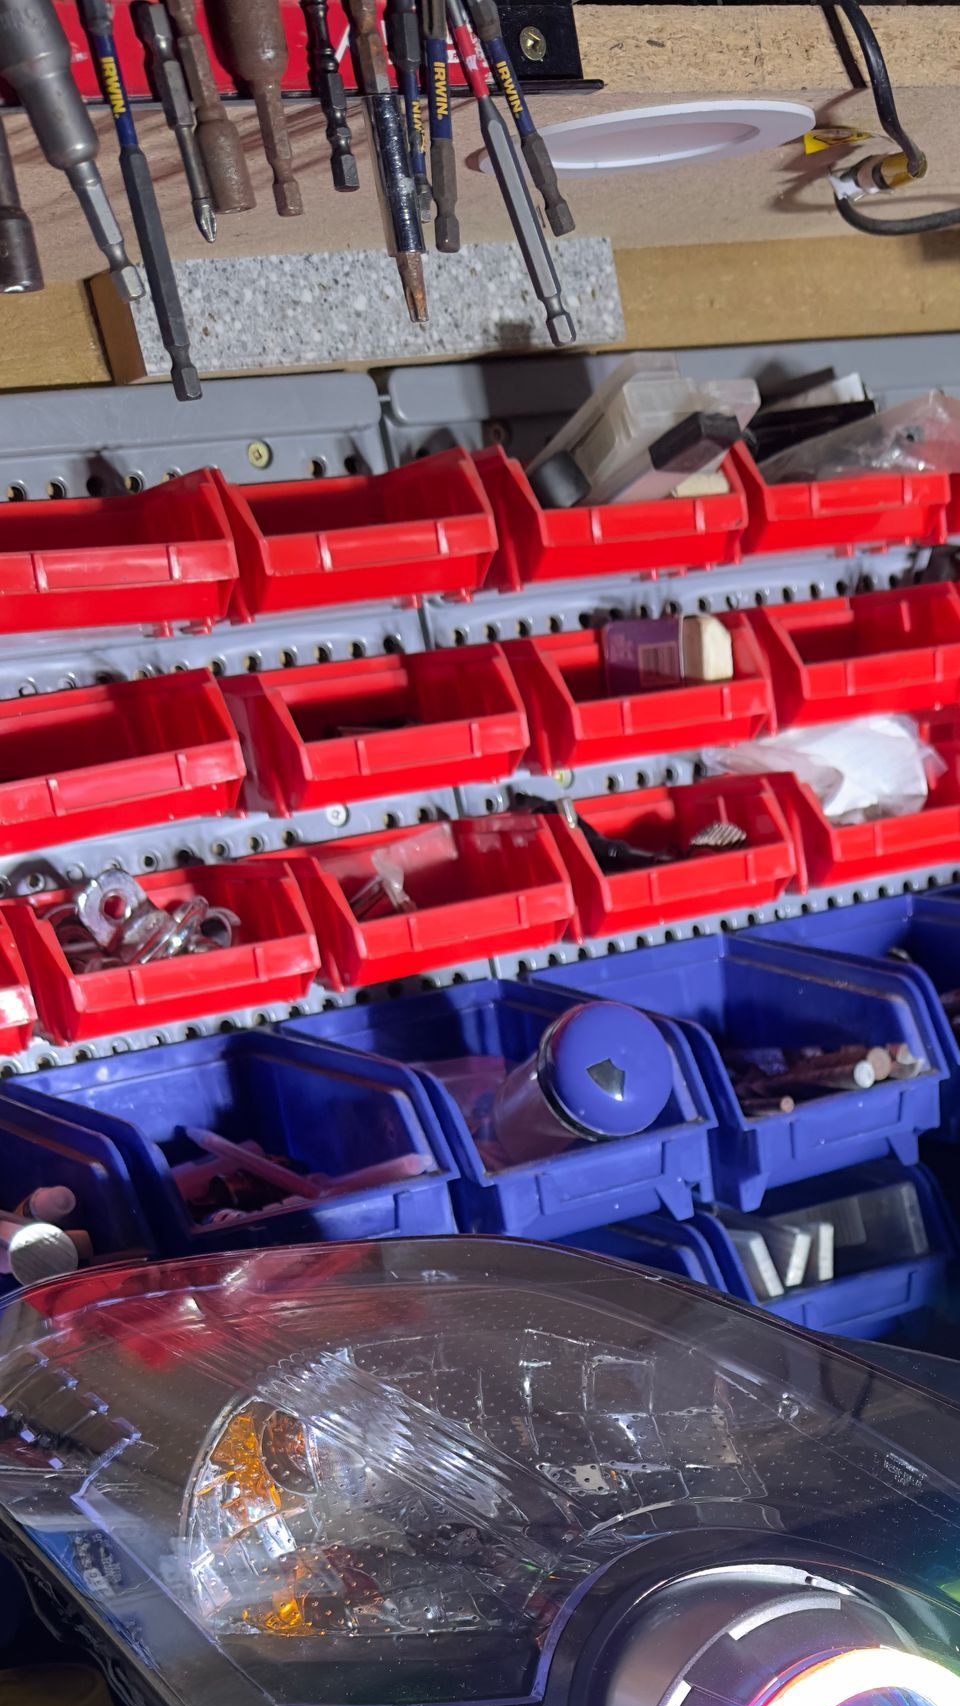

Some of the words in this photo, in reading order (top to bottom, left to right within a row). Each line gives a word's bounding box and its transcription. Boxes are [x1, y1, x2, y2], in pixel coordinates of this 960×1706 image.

[101, 57, 126, 114] IRWIN
[433, 62, 449, 117] IRWIN
[496, 61, 523, 115] IRWIN
